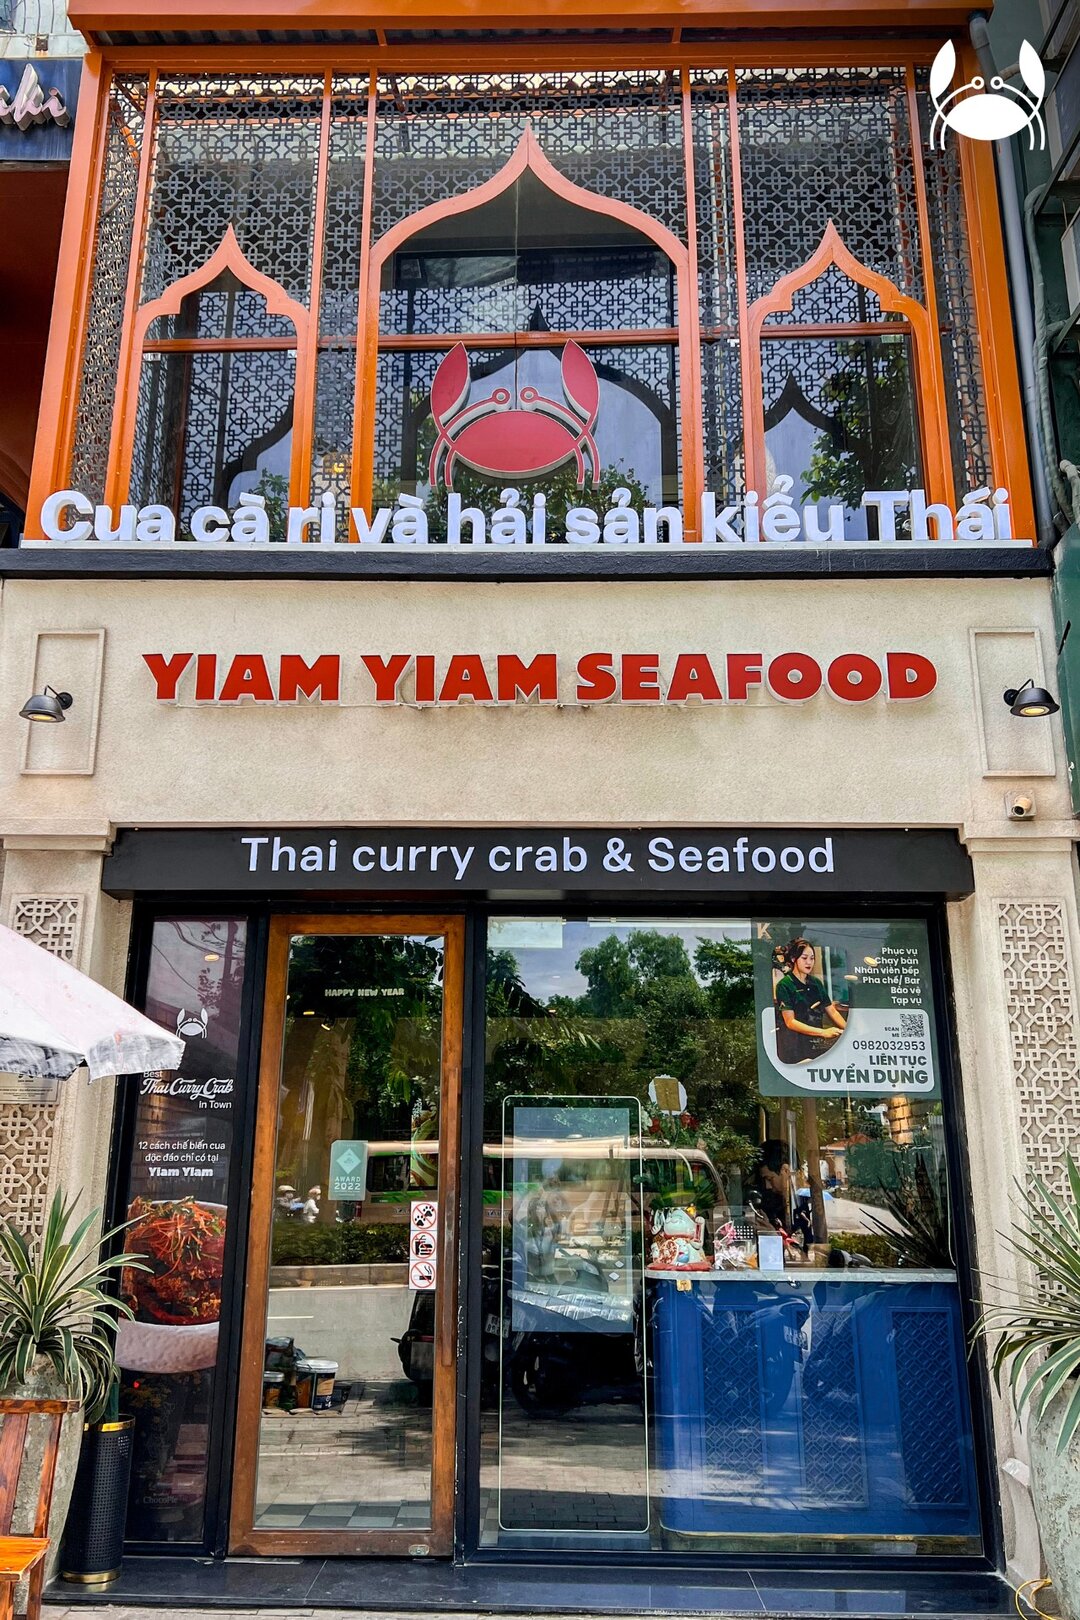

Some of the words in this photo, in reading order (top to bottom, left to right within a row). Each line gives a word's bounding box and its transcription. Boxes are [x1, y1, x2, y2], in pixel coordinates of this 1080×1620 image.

[41, 490, 175, 542] Cua
[191, 493, 270, 543] cà
[288, 492, 337, 543] ri
[353, 493, 429, 544] và
[447, 488, 546, 544] hải
[565, 488, 683, 544] sản
[702, 474, 850, 542] kiểu
[862, 486, 1012, 541] Thái
[142, 653, 341, 704] YIAM
[361, 652, 558, 704] YIAM
[576, 652, 938, 703] SEAFOOD
[241, 837, 338, 872] Thai
[352, 844, 475, 880] curry
[488, 837, 588, 872] crab
[602, 837, 635, 872] &
[648, 837, 835, 873] Seafood
[881, 947, 905, 957] Phục
[906, 948, 918, 957] vụ
[875, 956, 899, 966] Chạy
[901, 956, 919, 965] bàn
[854, 966, 879, 974] Nhân
[880, 966, 900, 974] viên
[902, 966, 920, 976] bếp
[862, 976, 880, 984] Pha
[324, 988, 355, 997] HAPPY
[357, 988, 378, 997] NEW
[381, 988, 405, 996] YEAR
[890, 986, 908, 994] Bảo
[909, 986, 921, 996] vệ
[891, 996, 909, 1006] Tạp
[909, 997, 922, 1006] vụ
[852, 1040, 926, 1051] 0982032953
[869, 1053, 898, 1066] LIÊN
[899, 1055, 927, 1069] TỤC
[143, 1070, 163, 1078] Best
[806, 1062, 870, 1083] TUYỂN
[873, 1069, 928, 1088] DỤNG
[140, 1078, 169, 1095] Thai
[169, 1077, 211, 1100] Curry
[203, 1077, 234, 1095] Crab
[198, 1100, 207, 1109] In
[209, 1100, 232, 1109] Town
[138, 1141, 148, 1150] 12
[149, 1140, 170, 1150] cách
[171, 1139, 189, 1150] chế
[189, 1139, 208, 1150] biến
[209, 1142, 226, 1150] cua
[162, 1152, 179, 1162] đáo
[194, 1152, 206, 1162] có
[207, 1153, 219, 1163] tại
[148, 1167, 180, 1177] Yiam
[182, 1167, 214, 1177] Yiam
[334, 1182, 361, 1190] 2022
